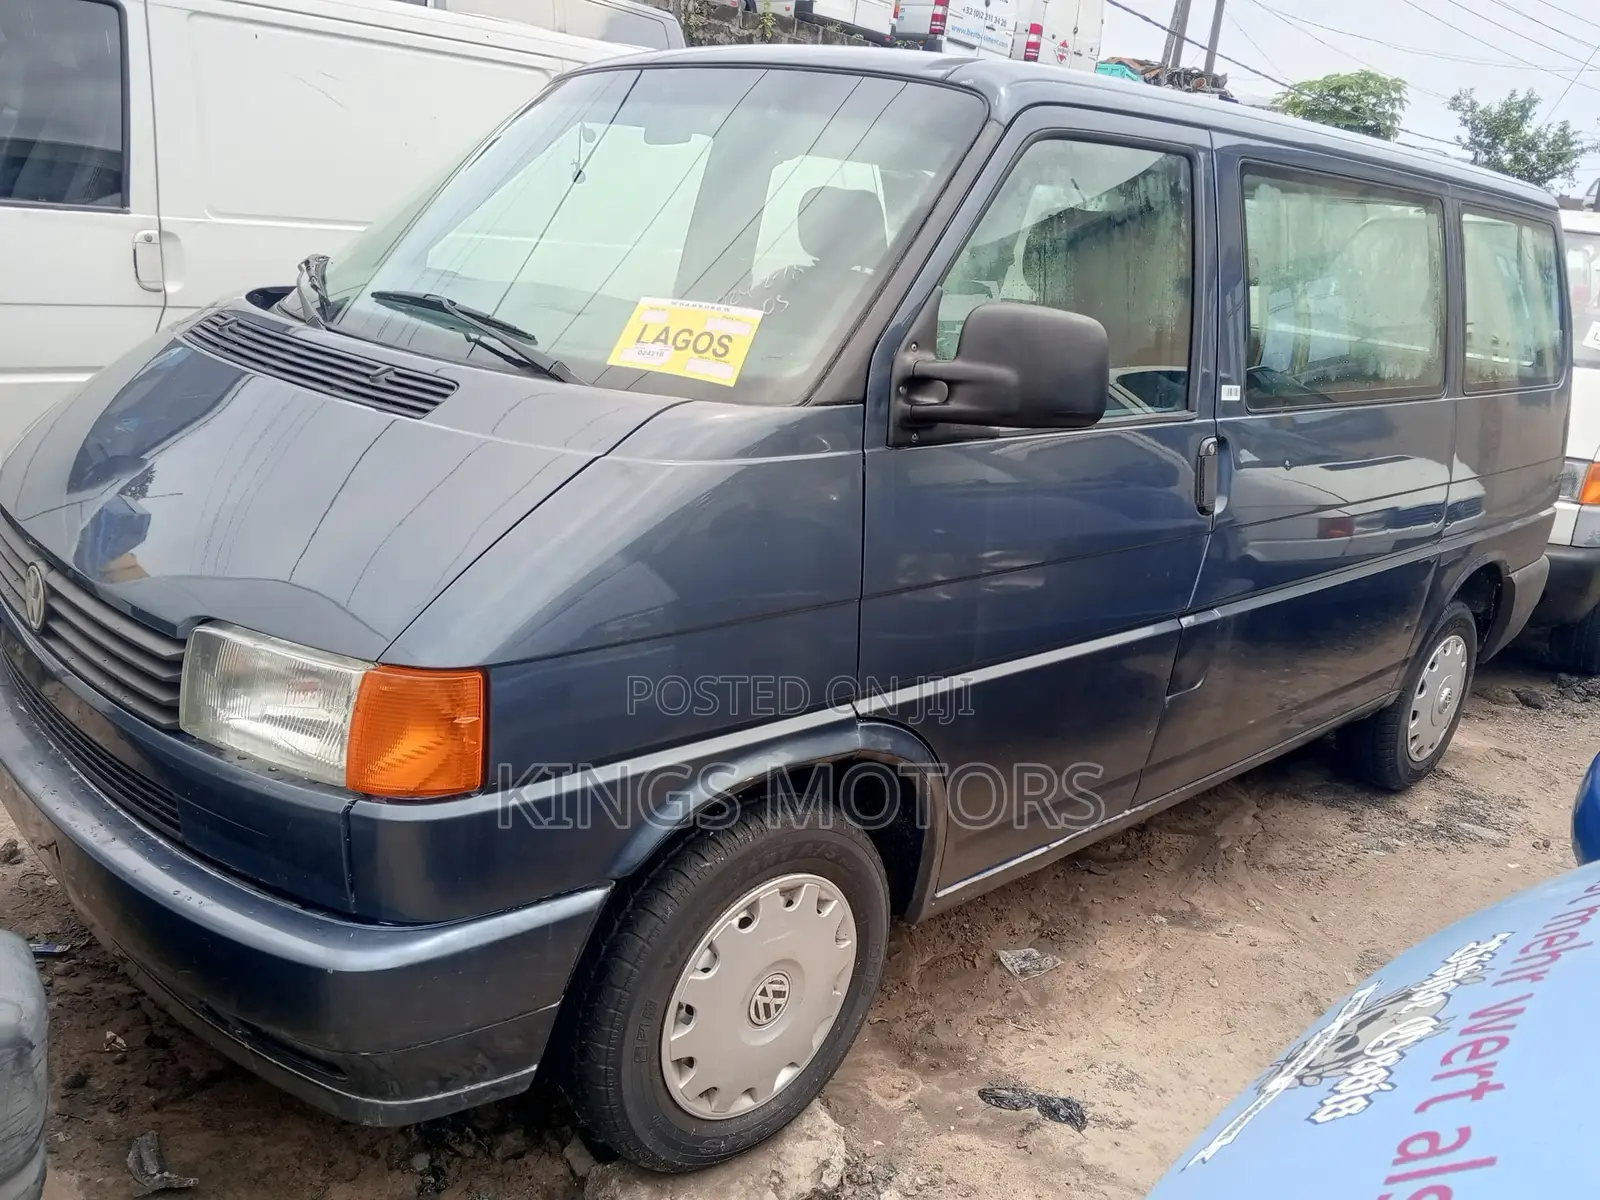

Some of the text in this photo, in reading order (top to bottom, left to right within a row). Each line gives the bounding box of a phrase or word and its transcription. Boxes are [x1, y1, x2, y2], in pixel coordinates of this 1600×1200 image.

[635, 323, 733, 358] LAGOS
[1491, 904, 1600, 988] mehr
[1414, 993, 1535, 1115] wert
